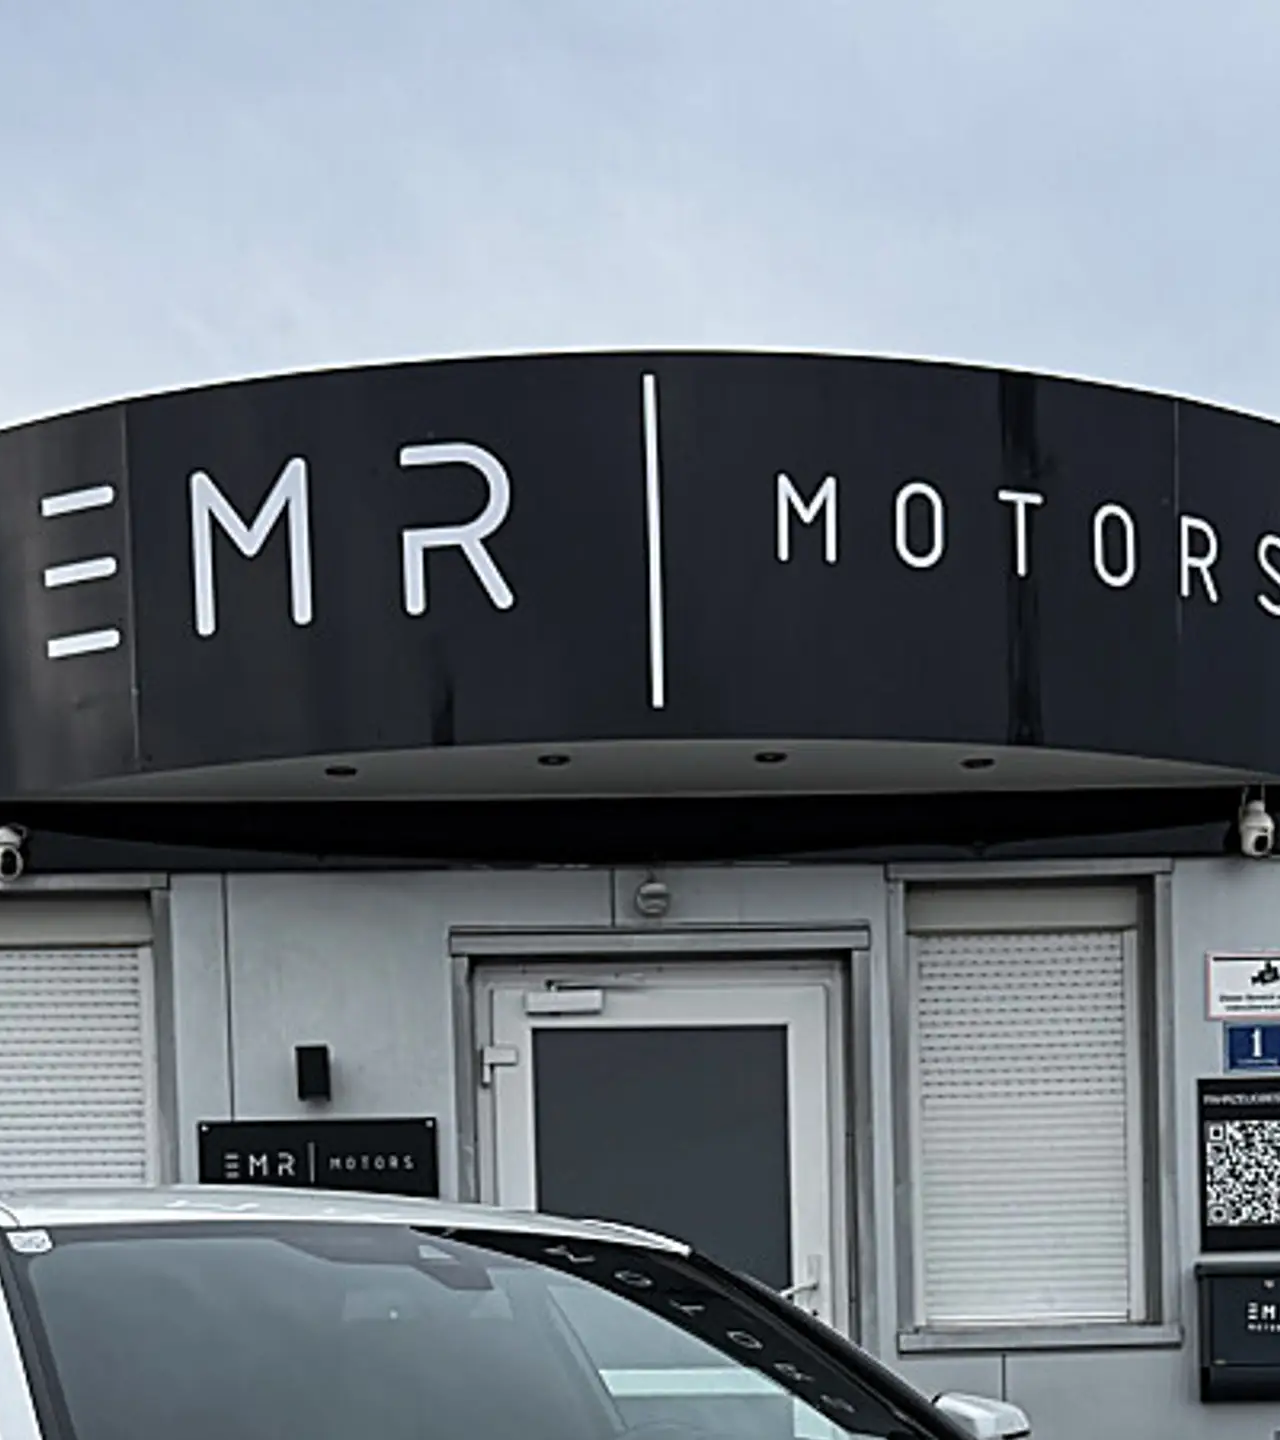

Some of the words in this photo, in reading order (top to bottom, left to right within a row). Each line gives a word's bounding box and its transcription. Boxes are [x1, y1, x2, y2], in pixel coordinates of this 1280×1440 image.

[41, 443, 514, 658] EMR
[1251, 1028, 1263, 1058] 1
[225, 1152, 296, 1178] EMR
[330, 1155, 414, 1170] MOTORS
